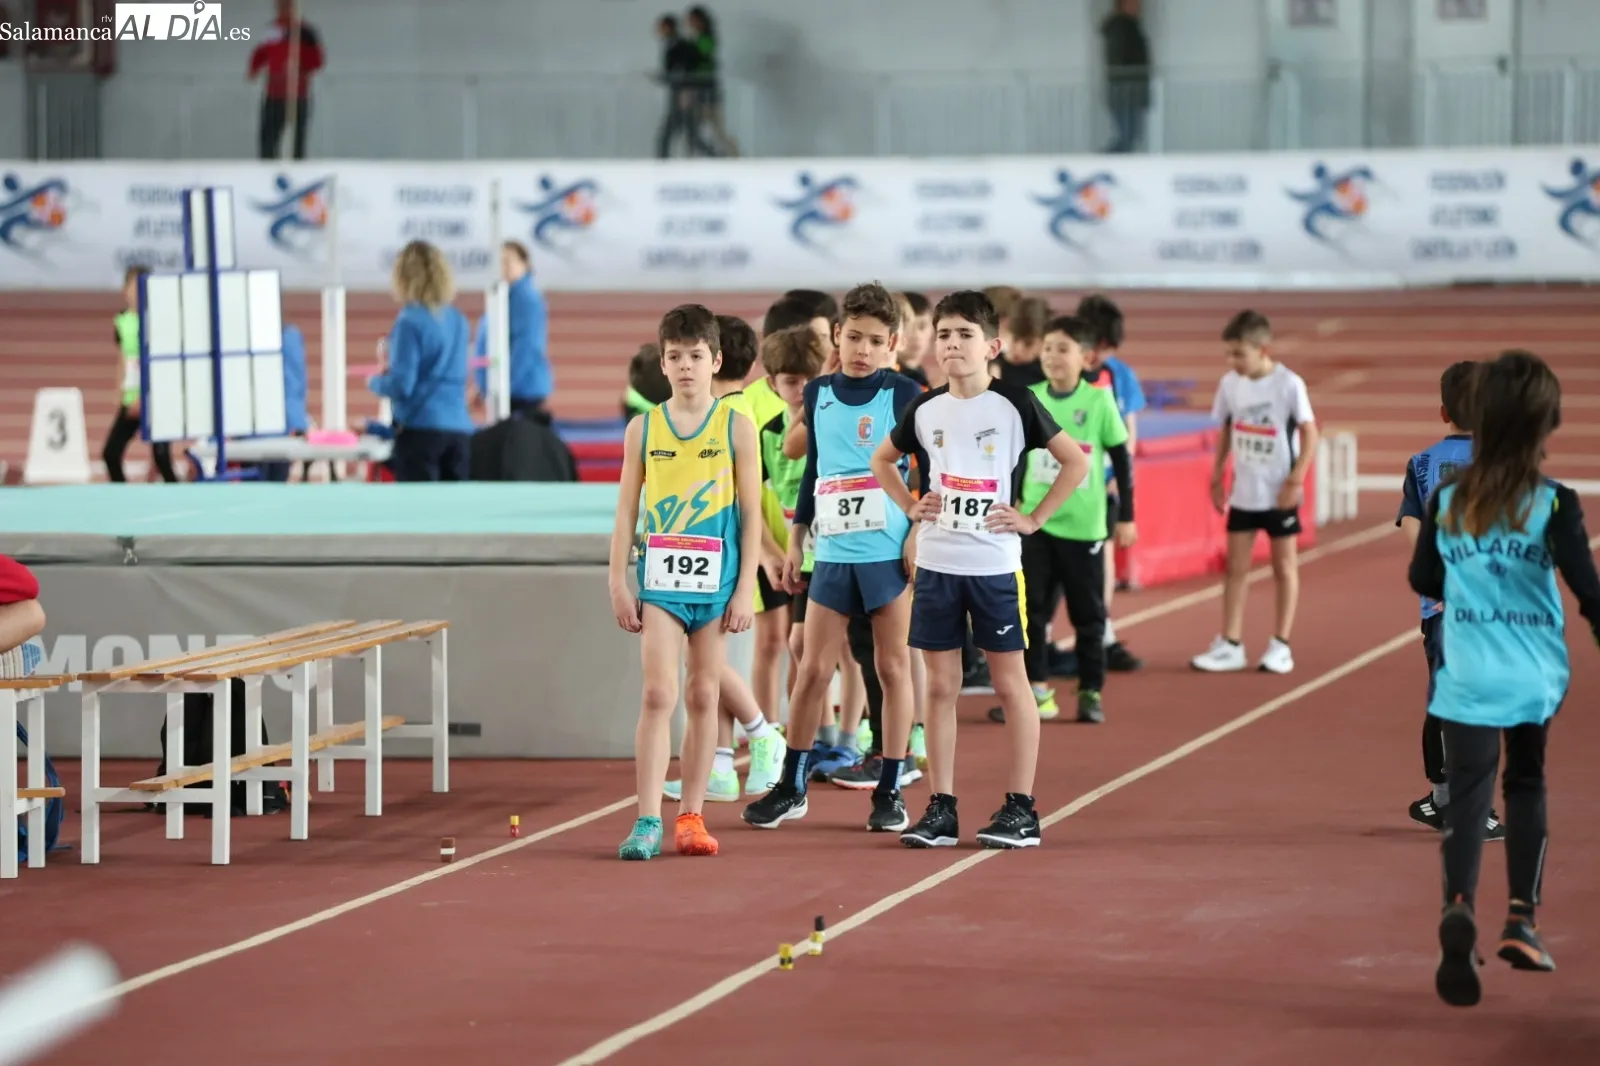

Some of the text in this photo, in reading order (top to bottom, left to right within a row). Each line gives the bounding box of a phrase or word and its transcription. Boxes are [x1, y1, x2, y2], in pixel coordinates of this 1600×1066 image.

[47, 408, 68, 451] 3
[838, 497, 865, 516] 87
[663, 555, 709, 576] 192
[1442, 537, 1552, 570] VILLARES
